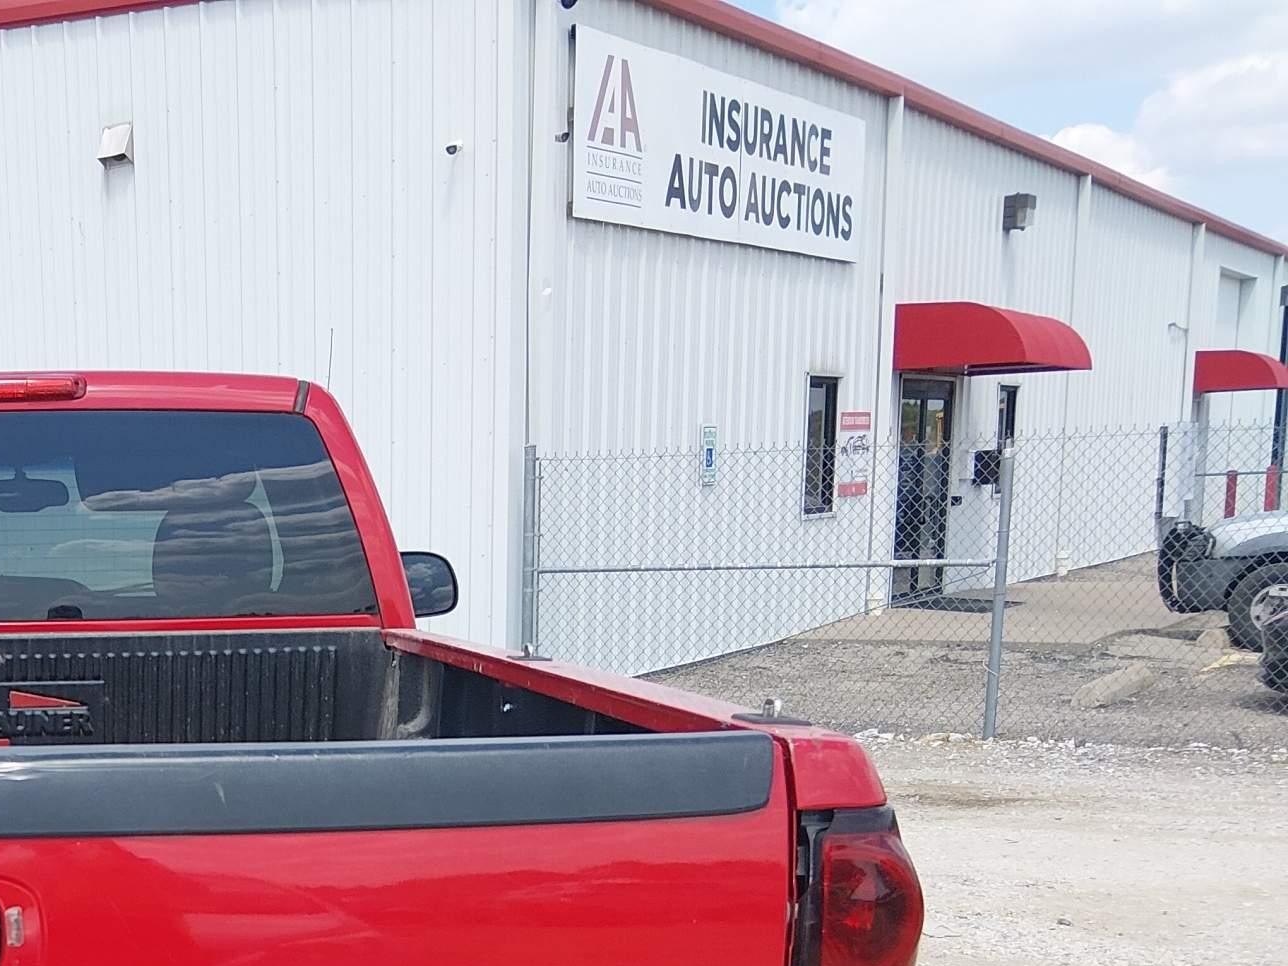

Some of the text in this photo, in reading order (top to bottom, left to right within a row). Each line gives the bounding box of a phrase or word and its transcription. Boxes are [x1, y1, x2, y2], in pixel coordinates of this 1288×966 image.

[701, 90, 832, 176] INSURANCE
[587, 152, 642, 175] INSURANCE
[586, 180, 642, 202] AUTO AUCTIONS
[665, 153, 853, 241] AUTO AUCTIONS
